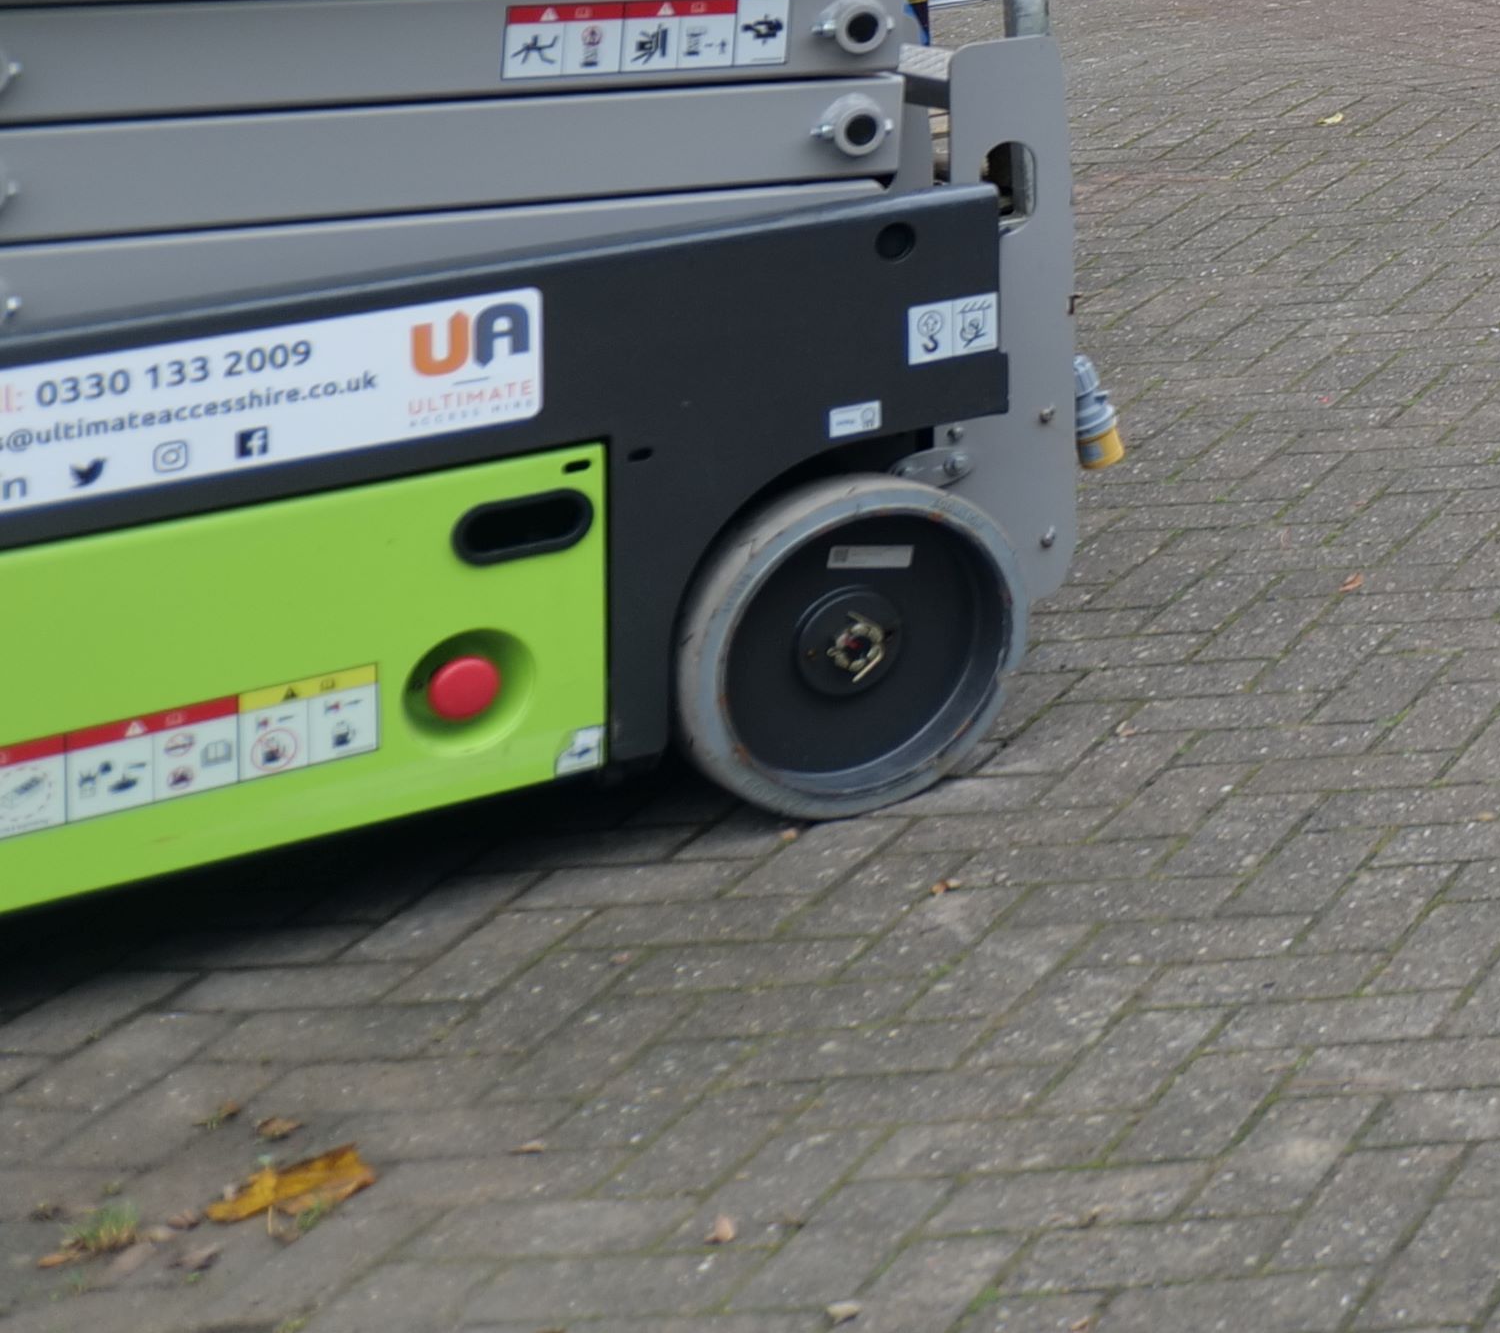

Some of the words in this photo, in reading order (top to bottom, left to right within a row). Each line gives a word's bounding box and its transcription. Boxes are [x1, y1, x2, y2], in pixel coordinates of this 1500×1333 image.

[36, 369, 131, 408] 0330
[145, 356, 210, 390] 133
[223, 339, 312, 378] 2009
[410, 301, 530, 377] UA
[408, 379, 534, 416] ULTIMATE
